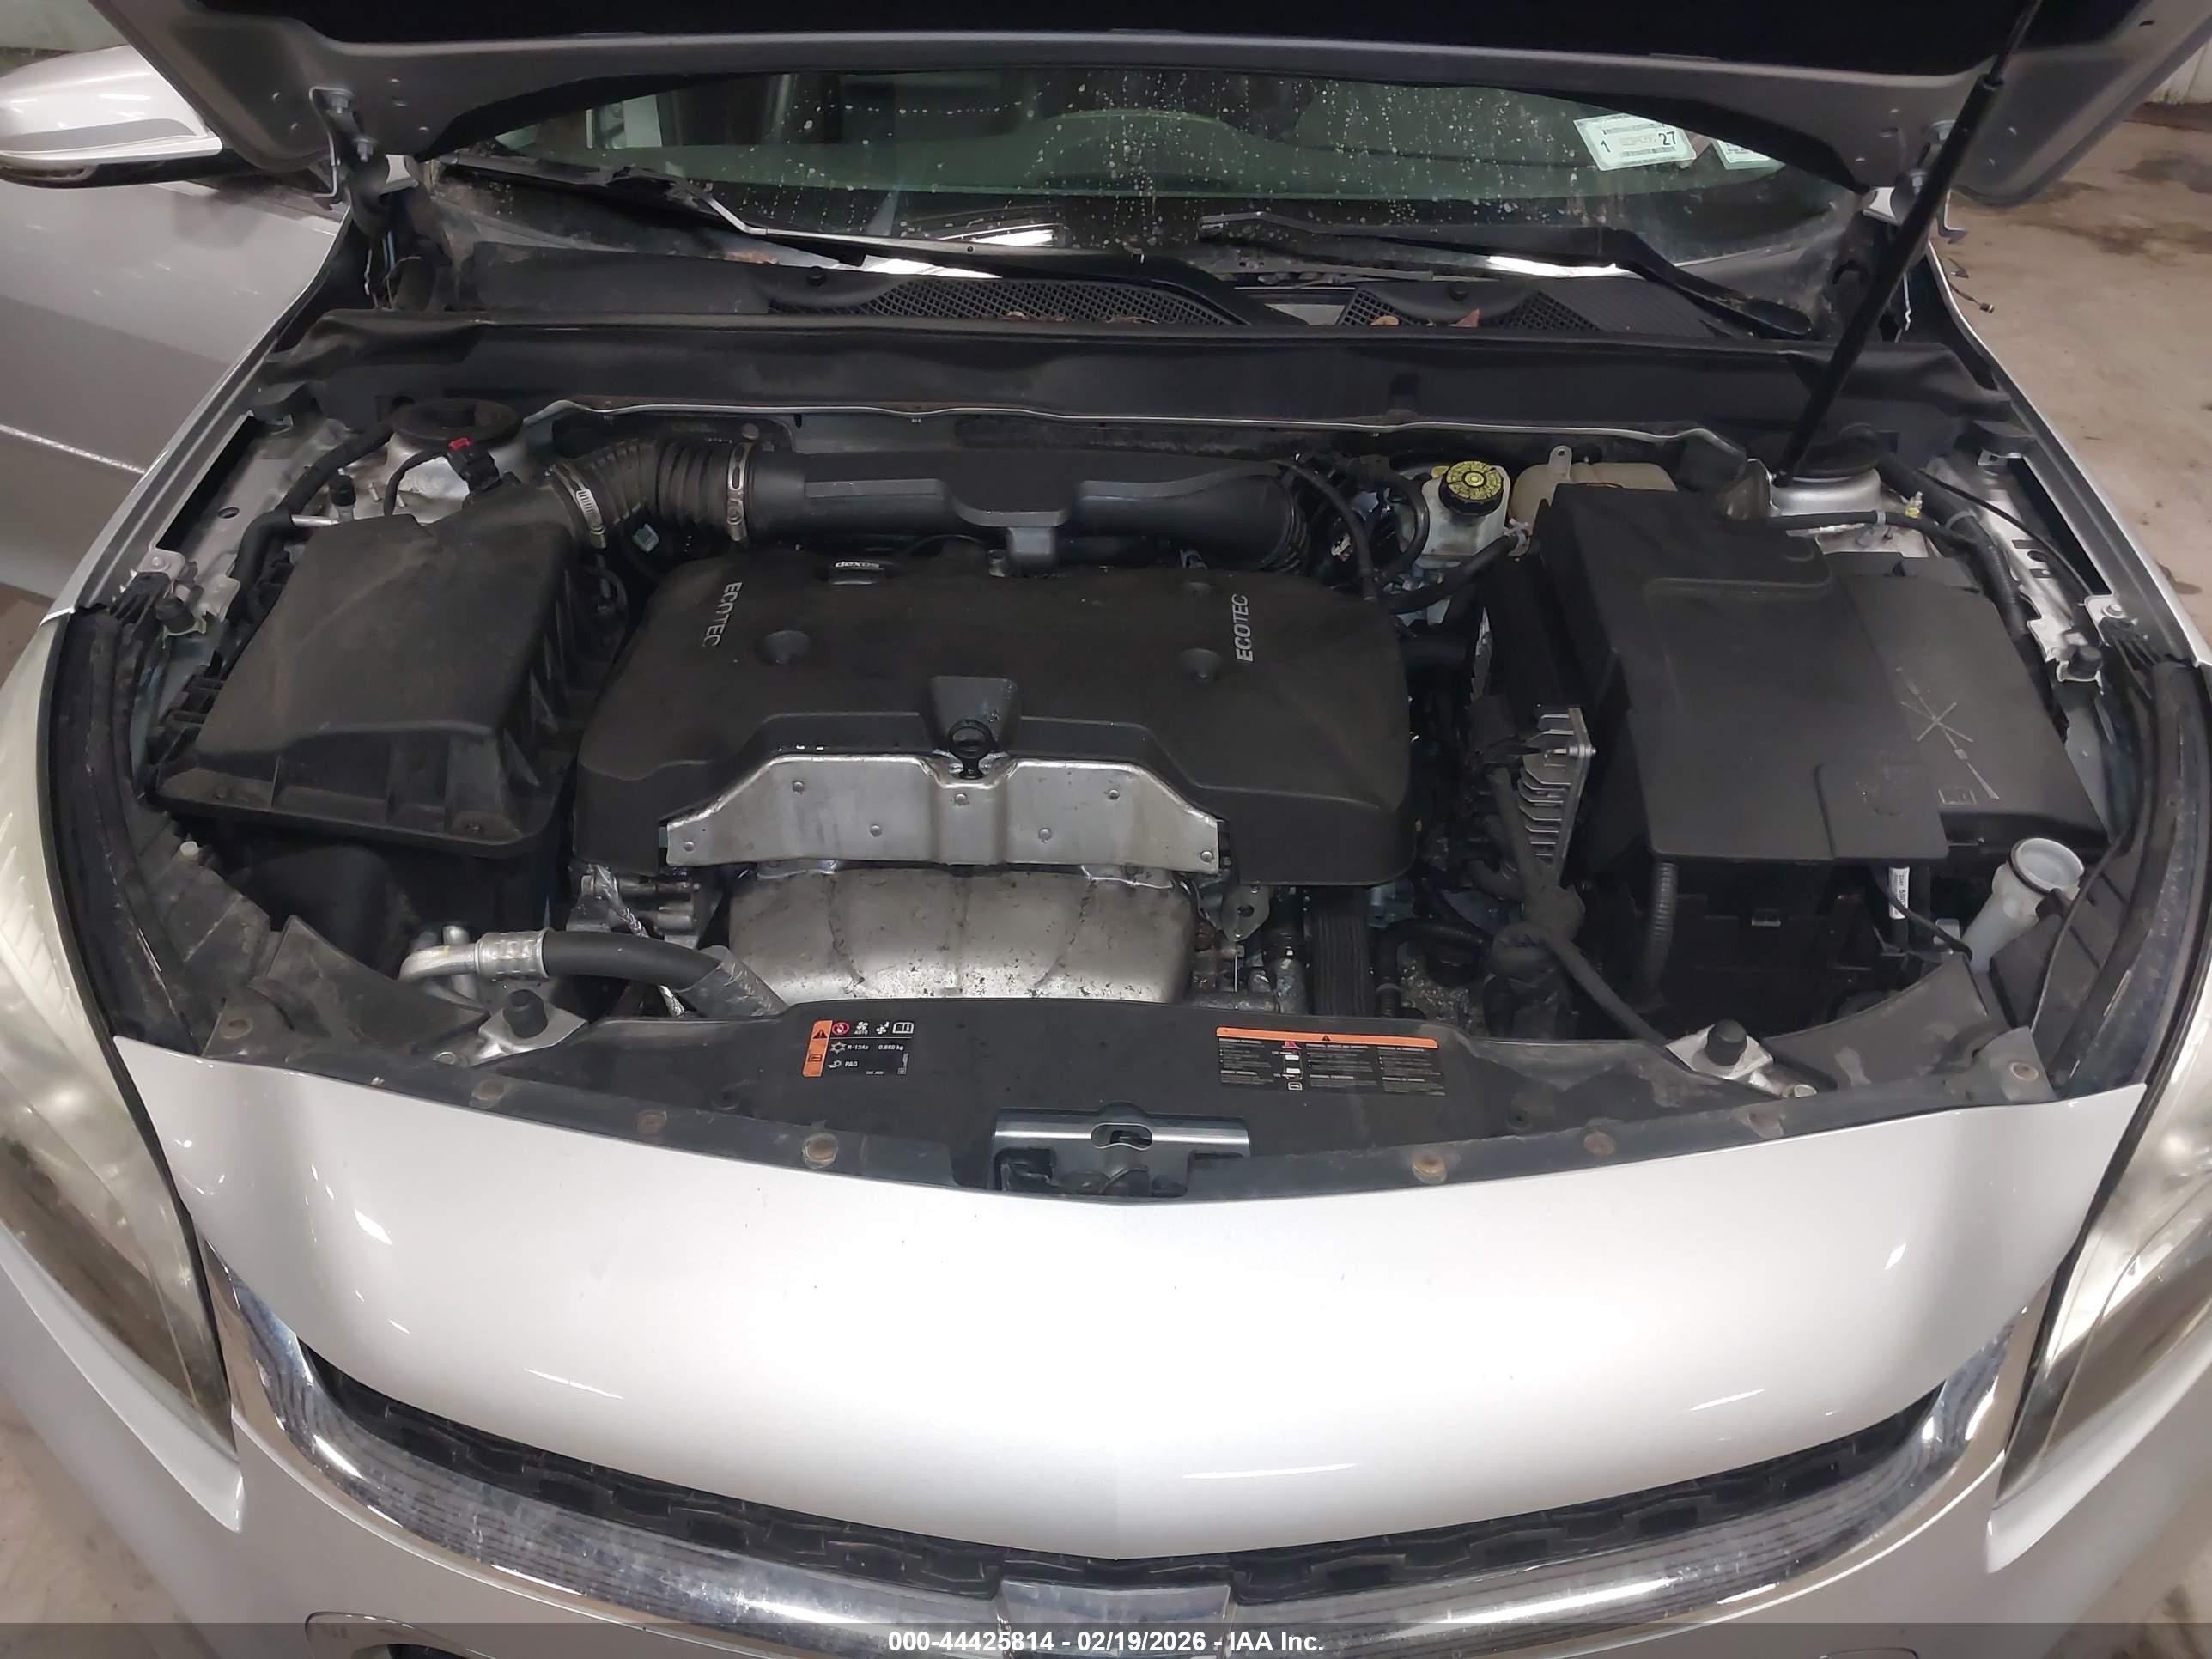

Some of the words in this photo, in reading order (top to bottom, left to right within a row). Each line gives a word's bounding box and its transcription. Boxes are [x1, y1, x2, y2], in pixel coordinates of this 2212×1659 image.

[1601, 141, 1610, 153] 1
[1658, 131, 1676, 146] 27
[702, 581, 743, 647] ECOTEC
[1231, 593, 1254, 662] ECOTEC
